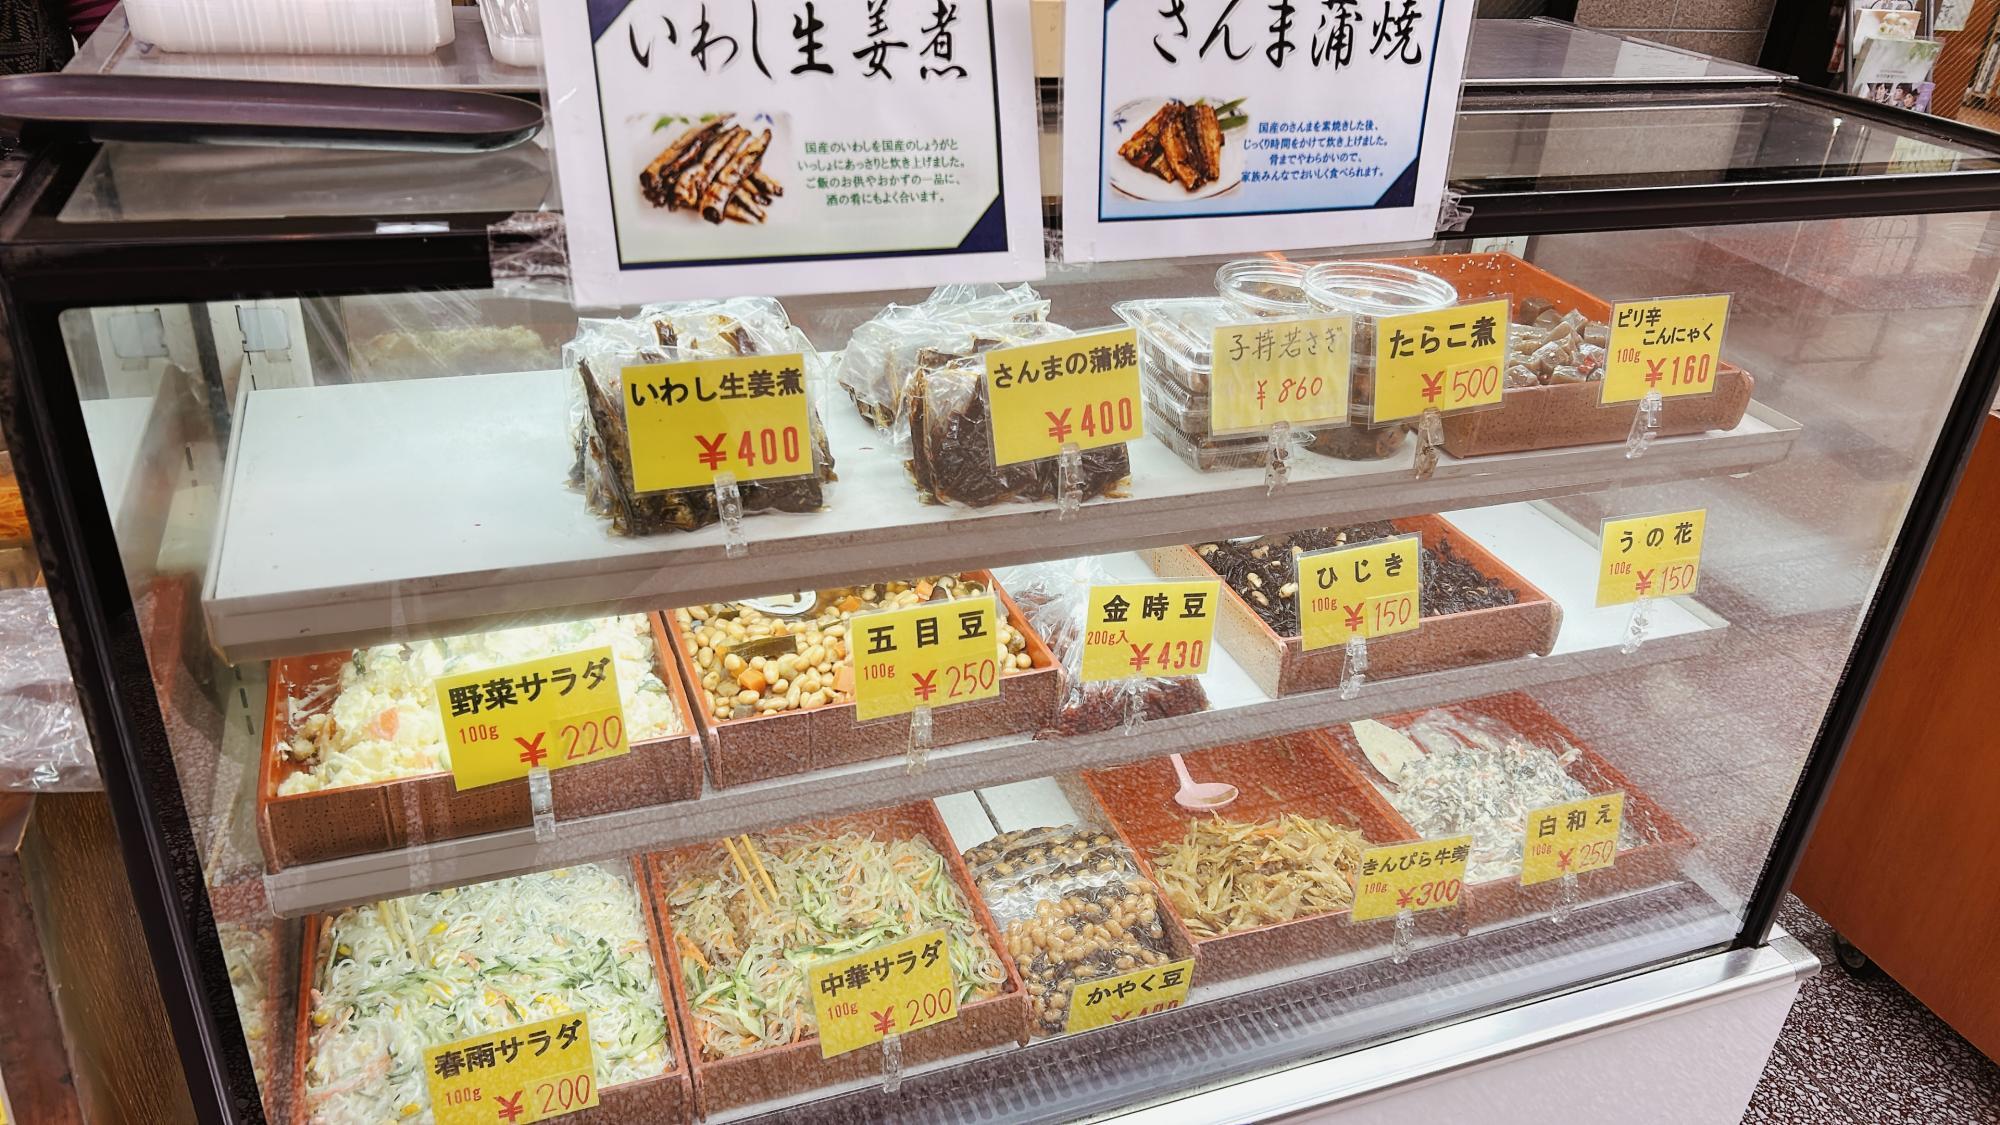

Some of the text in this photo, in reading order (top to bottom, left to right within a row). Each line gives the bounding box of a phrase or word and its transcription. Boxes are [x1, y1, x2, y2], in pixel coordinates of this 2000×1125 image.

[629, 0, 968, 80] いわし生姜煮
[1153, 0, 1423, 71] さんま蒲焼
[1243, 135, 1388, 150] じっくり時間をかけて炊き上げました。
[1258, 119, 1378, 134] 国産のさんまを素焼きした後、
[797, 156, 966, 172] いっしょにあっさりと炊き上げました。
[804, 138, 959, 155] 国産のいわしを国産のしょうがと
[1269, 152, 1362, 166] 骨までやわらかいので、
[1240, 166, 1384, 183] 家族みんなでおいしく食べられます。
[1618, 306, 1662, 328] ピリ辛
[1642, 322, 1713, 346] こんにゃく
[1229, 326, 1343, 362] 子持若さぎ
[1389, 316, 1497, 359] たらこ煮
[993, 341, 1137, 389] さんまの蒲焼
[1421, 365, 1498, 403] ¥500
[1617, 348, 1711, 388] 100g ¥160
[630, 367, 805, 407] いわし生姜煮
[1256, 376, 1323, 410] ¥860
[1044, 397, 1133, 443] ¥400
[693, 426, 800, 471] ¥400
[1620, 521, 1693, 554] うの花
[1316, 552, 1404, 590] ひじき
[1609, 561, 1695, 595] 100g ¥150
[1102, 592, 1208, 623] 金時豆
[1312, 597, 1412, 632] 100g ¥150
[867, 609, 988, 655] 五目豆
[1086, 630, 1204, 672] 200g入 ¥430
[448, 656, 611, 718] 野菜サラダ
[863, 658, 996, 701] 100g ¥250
[459, 715, 623, 768] 100g ¥220
[1538, 803, 1613, 838] 白和え
[1362, 844, 1471, 876] きんぴら牛蒡
[1556, 839, 1614, 872] ¥250
[1396, 879, 1461, 908] ¥300
[820, 939, 944, 998] 中華サラダ
[1085, 967, 1185, 1007] かやく豆
[827, 987, 952, 1035] 100g ¥200
[434, 1018, 583, 1080] 春雨サラダ
[445, 1074, 591, 1122] 100g ¥200
